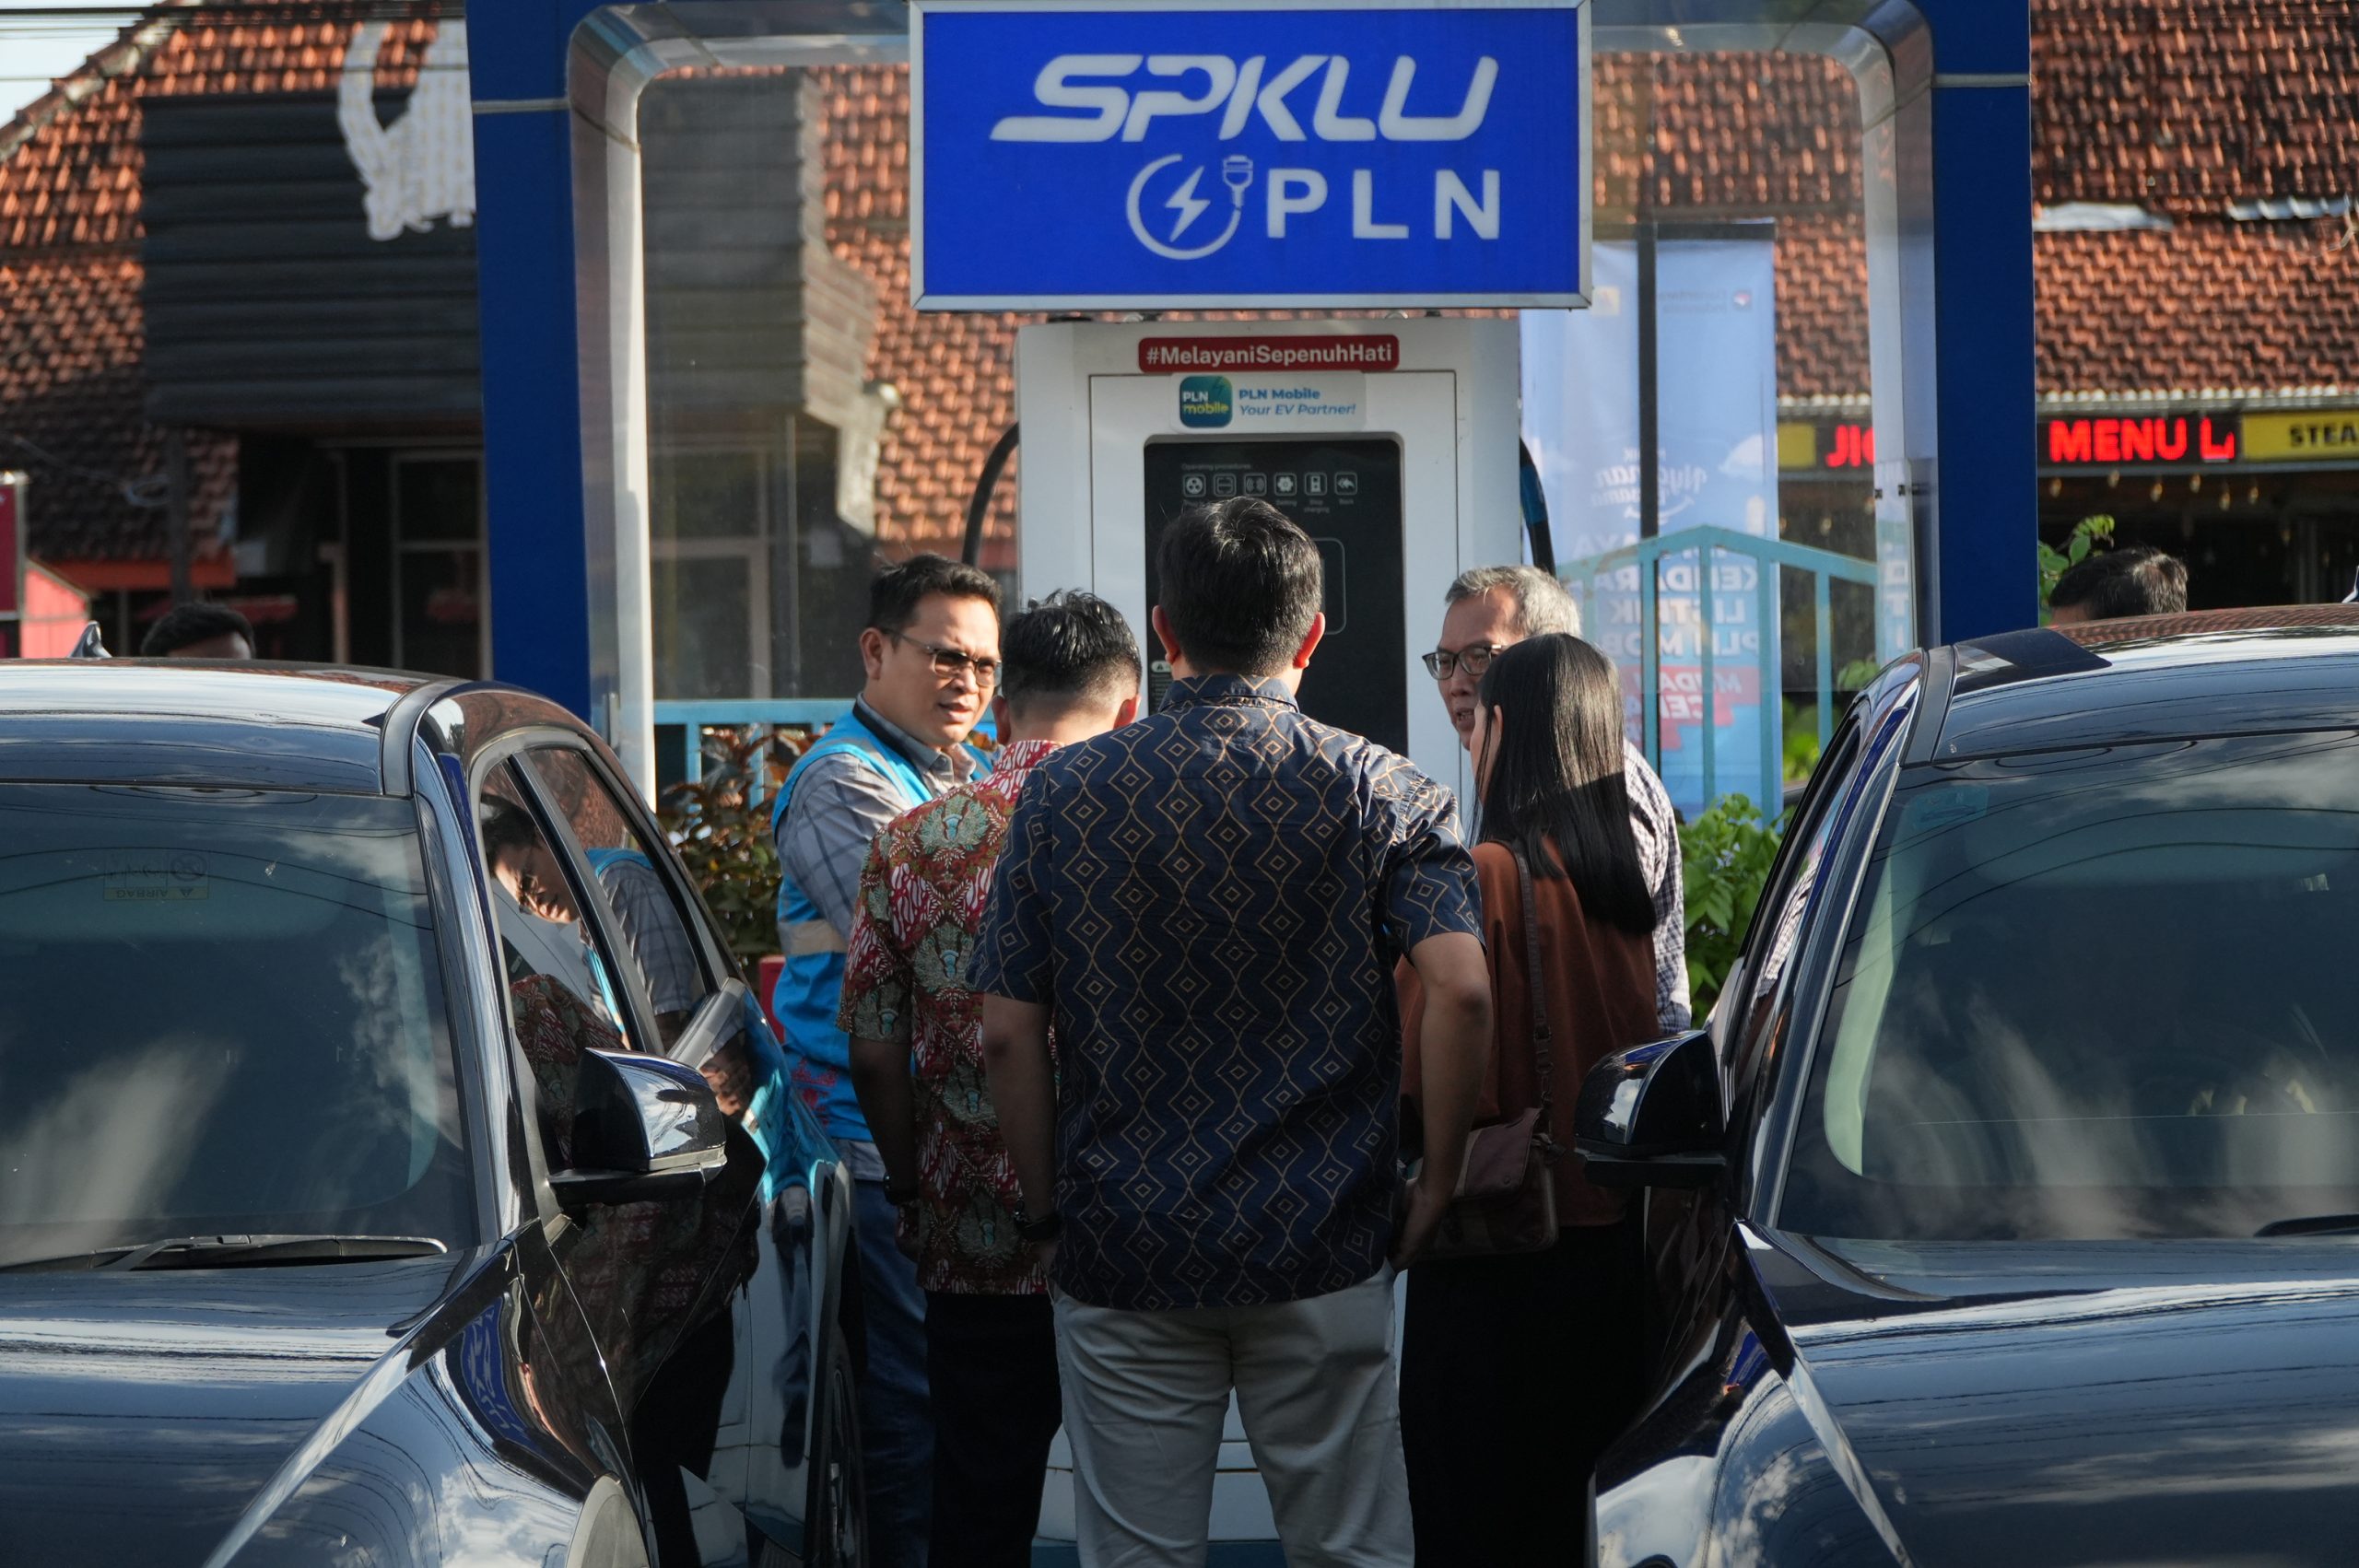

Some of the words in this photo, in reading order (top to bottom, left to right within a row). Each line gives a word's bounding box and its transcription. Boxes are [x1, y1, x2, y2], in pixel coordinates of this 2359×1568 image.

[990, 54, 1499, 142] SPKLU
[1267, 168, 1500, 240] PLN
[1146, 345, 1392, 367] #MelayaniSepenuhHati
[1183, 391, 1209, 403] PLN
[1239, 389, 1268, 400] PLN
[1272, 387, 1320, 400] Mobile
[1183, 402, 1229, 415] mobile
[1240, 405, 1271, 415] Your
[1275, 404, 1296, 415] EV
[1297, 404, 1356, 415] Partner!
[2048, 417, 2187, 462] MENU
[116, 889, 168, 899] AIRBAG
